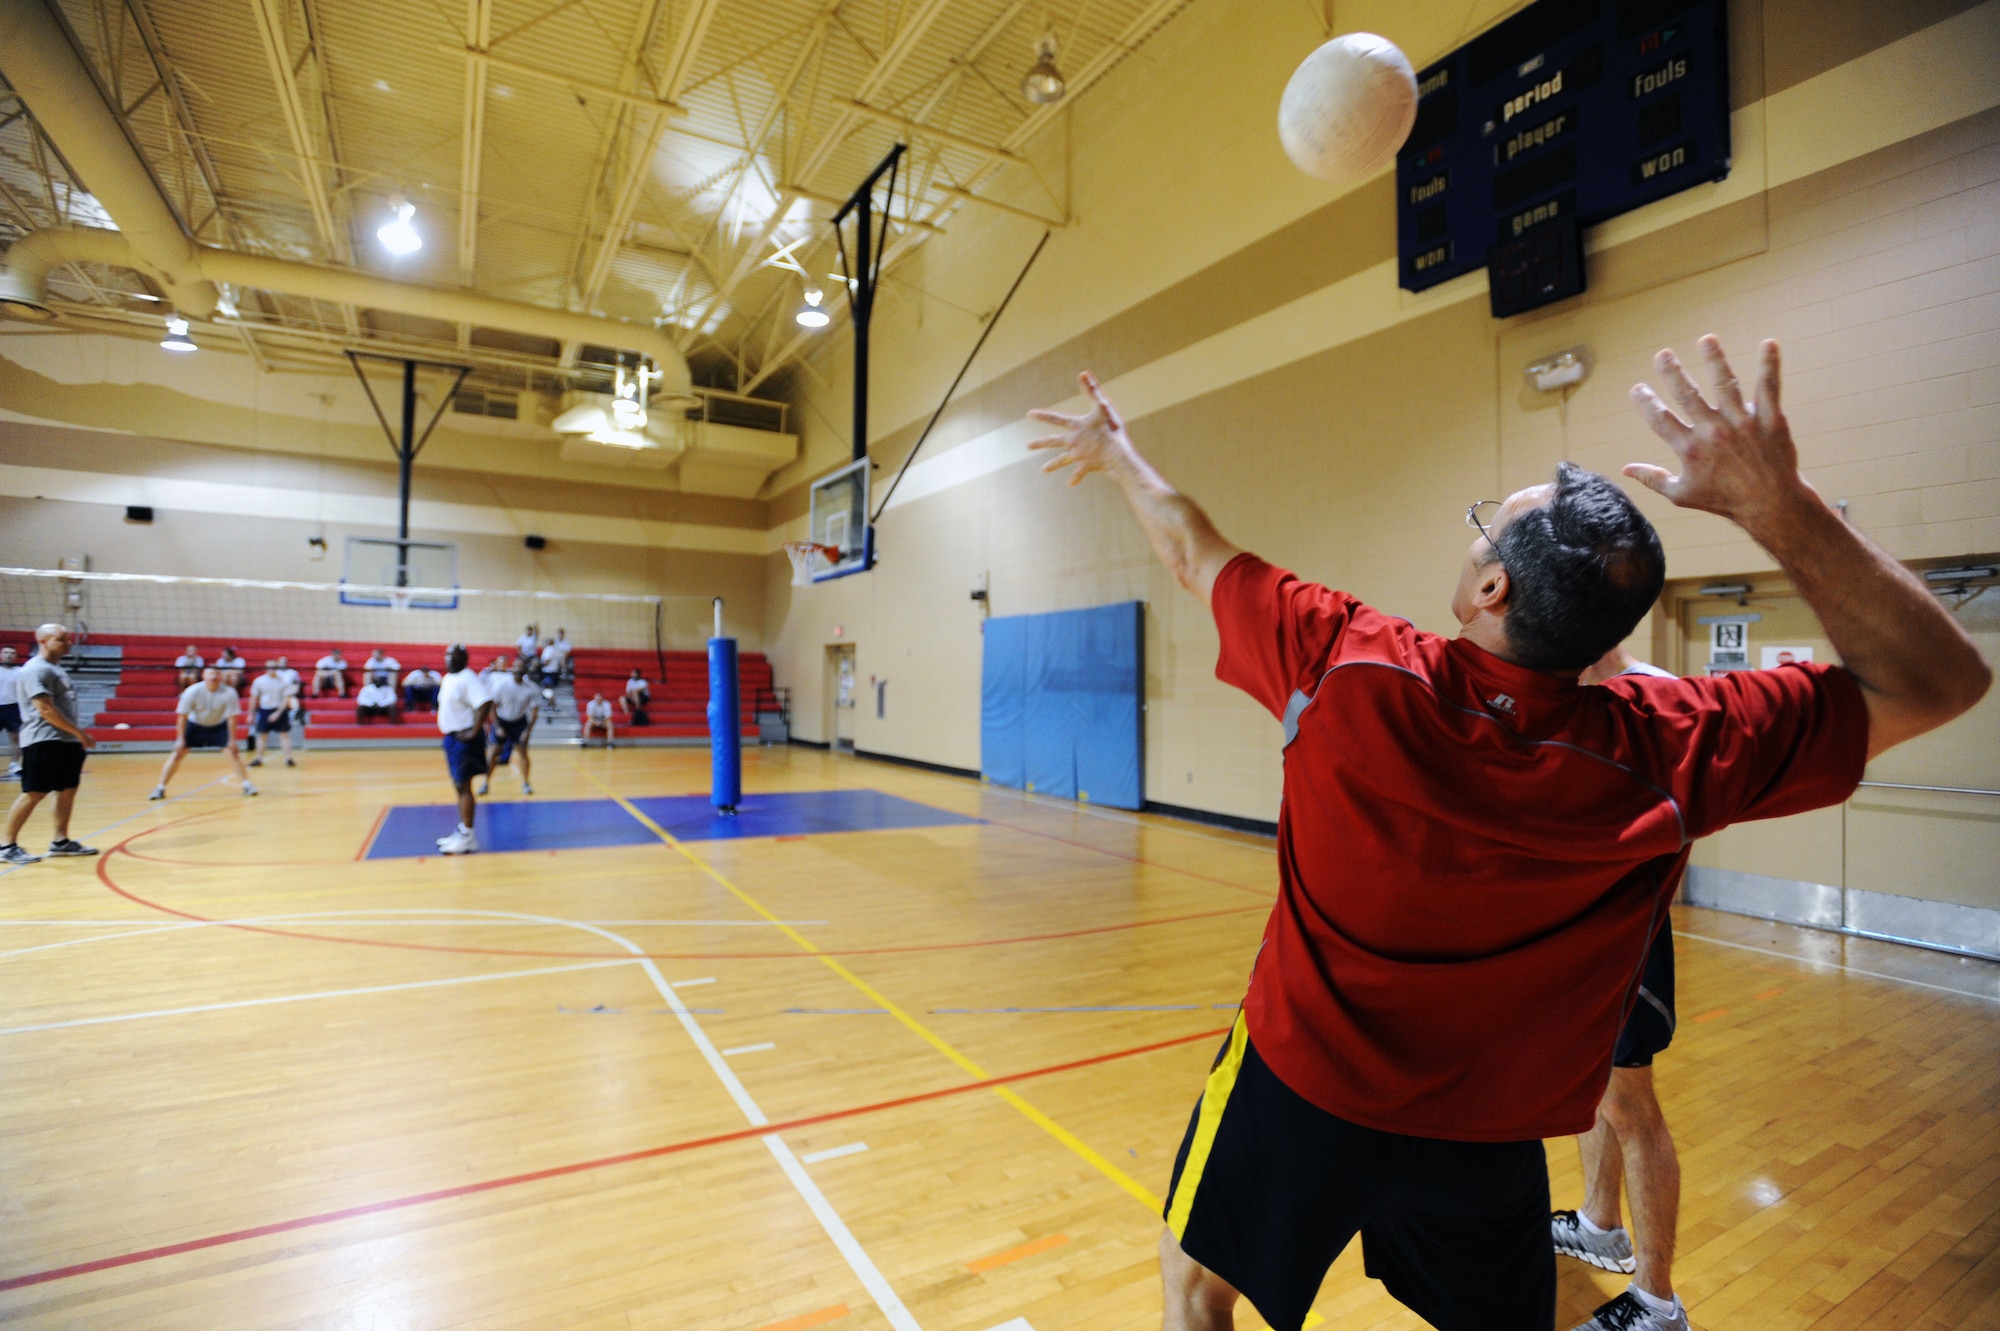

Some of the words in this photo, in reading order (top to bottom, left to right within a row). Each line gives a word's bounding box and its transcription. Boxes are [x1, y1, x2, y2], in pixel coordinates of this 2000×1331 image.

[1418, 69, 1448, 98] ome
[1635, 59, 1687, 98] fouls
[1503, 70, 1562, 122] period
[1507, 115, 1566, 160] player
[1641, 147, 1685, 179] won
[1410, 175, 1446, 204] fouls
[1512, 201, 1559, 236] game
[1415, 247, 1445, 271] won
